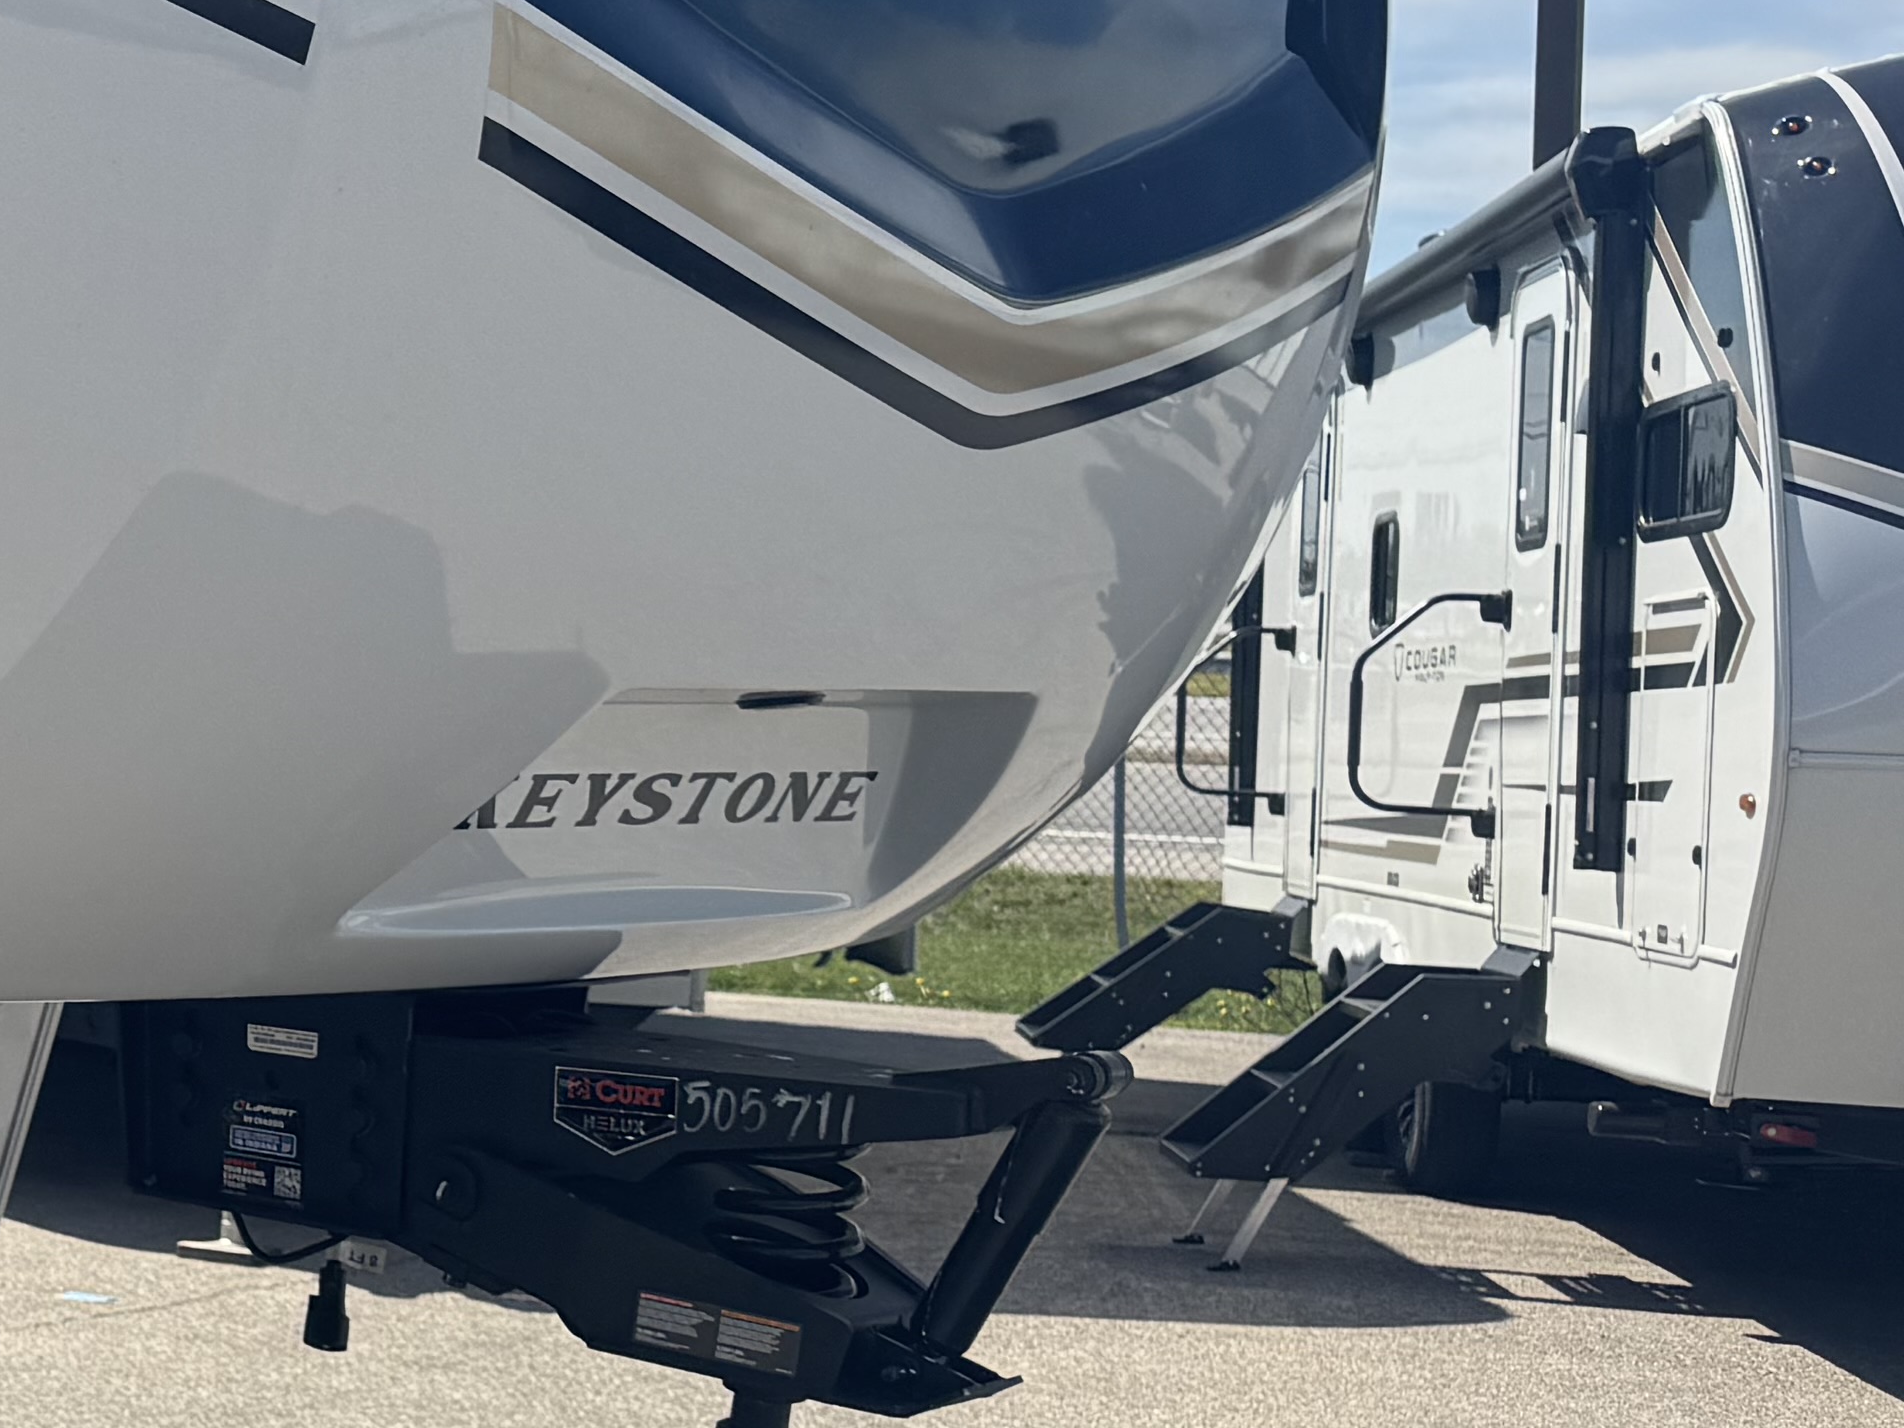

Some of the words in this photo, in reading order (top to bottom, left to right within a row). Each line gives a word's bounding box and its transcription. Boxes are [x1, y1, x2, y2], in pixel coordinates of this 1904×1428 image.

[1405, 644, 1457, 671] COUGAR
[595, 1079, 666, 1108] CURT
[682, 1080, 856, 1145] 505711
